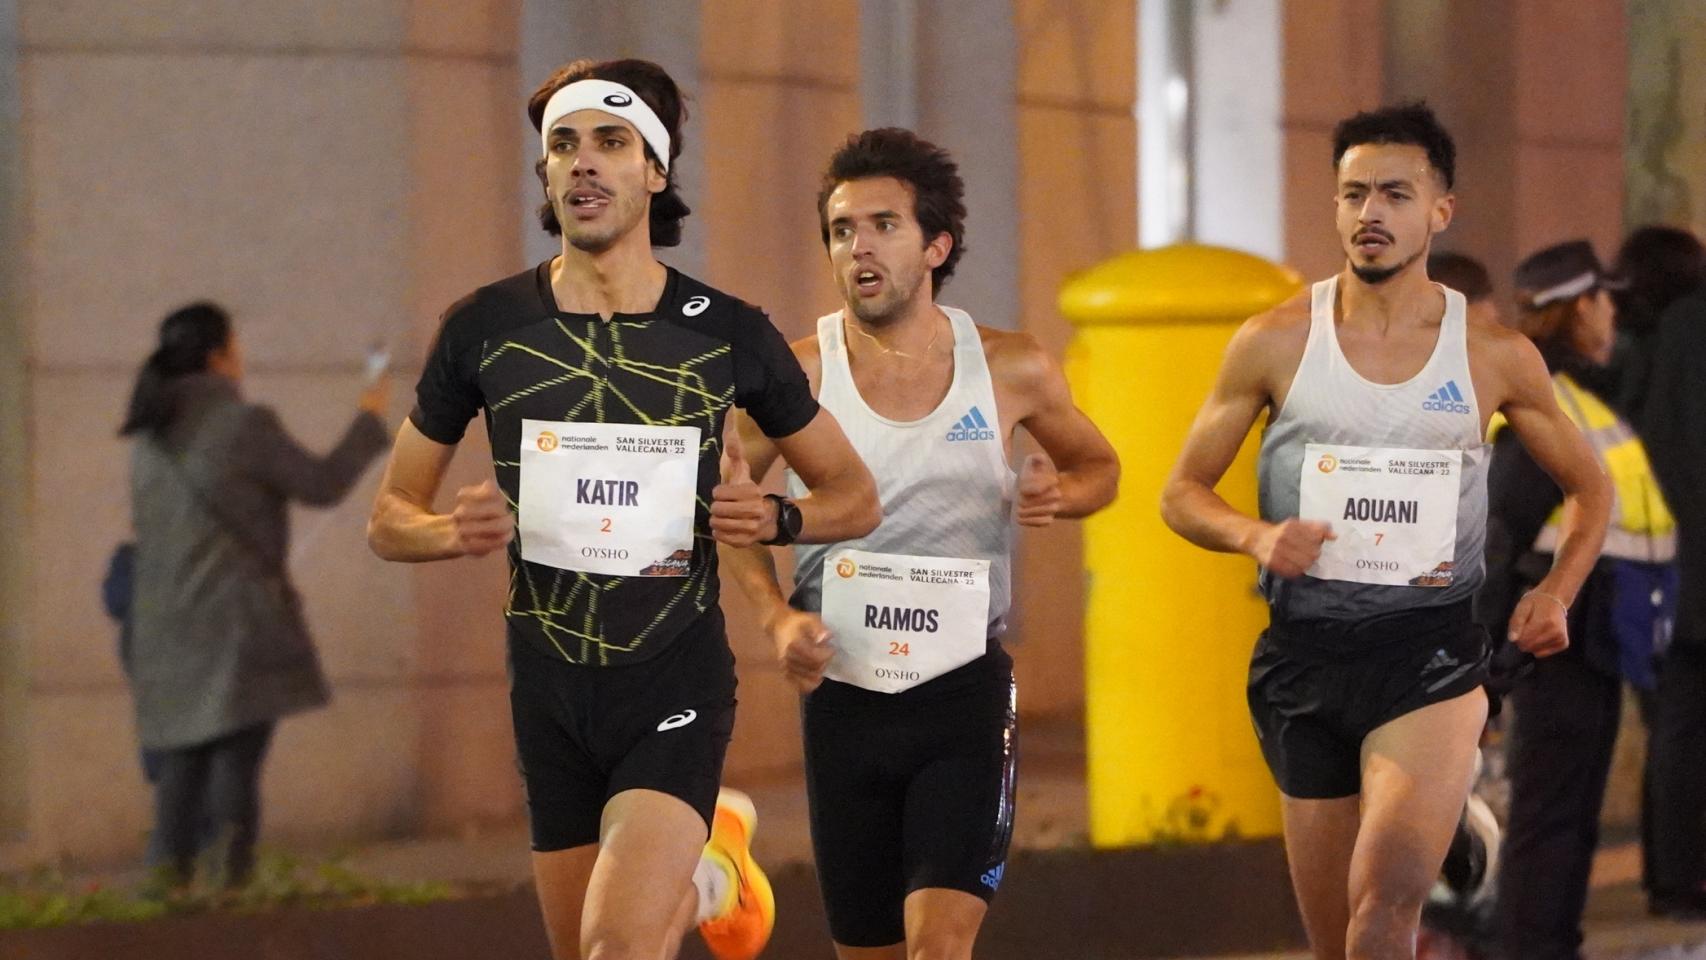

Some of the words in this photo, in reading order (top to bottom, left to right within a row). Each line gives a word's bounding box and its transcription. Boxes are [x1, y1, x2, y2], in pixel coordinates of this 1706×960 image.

[1422, 400, 1471, 414] adidas
[945, 428, 995, 441] adidas
[561, 443, 609, 451] nederlanden
[638, 438, 686, 446] SILVESTRE
[616, 445, 668, 453] VALLECANA
[1408, 460, 1450, 468] SILVESTRE
[1388, 467, 1434, 475] VALLECANA
[576, 478, 639, 507] KATIR
[1343, 497, 1418, 524] AOUANI
[600, 518, 612, 533] 2
[1374, 533, 1384, 546] 7
[581, 547, 629, 560] OYSHO
[858, 564, 892, 573] nationale
[1356, 559, 1399, 571] OYSHO
[858, 572, 904, 581] nederlanden
[910, 568, 928, 576] SAN
[931, 569, 974, 578] SILVESTRE
[910, 575, 958, 584] VALLECANA
[864, 604, 939, 633] RAMOS
[888, 641, 910, 656] 24
[875, 667, 920, 681] OYSHO
